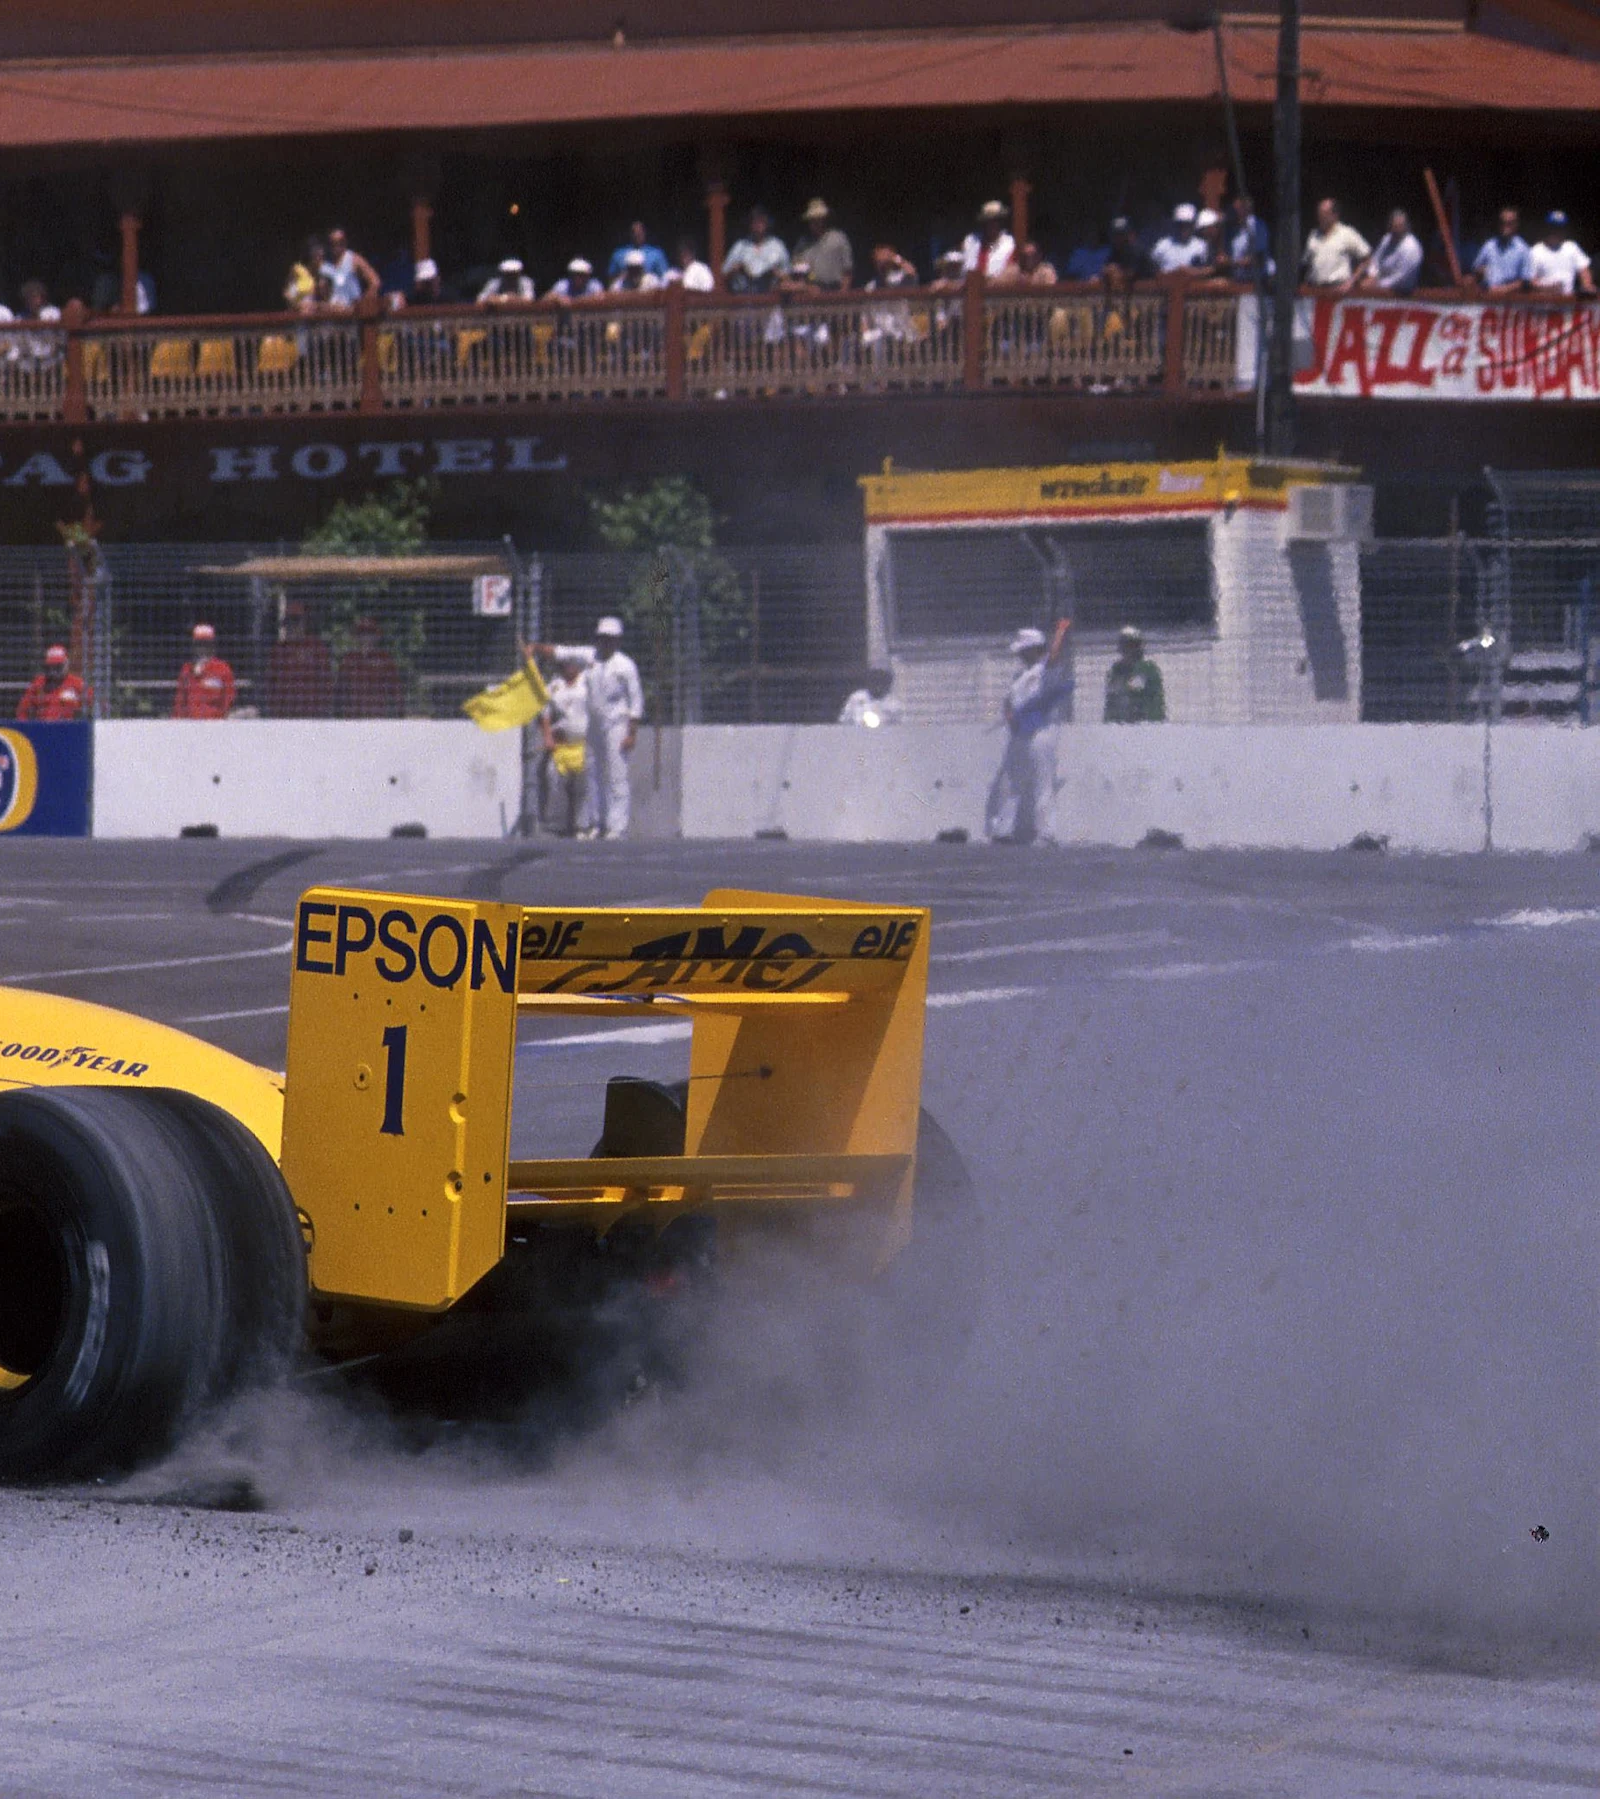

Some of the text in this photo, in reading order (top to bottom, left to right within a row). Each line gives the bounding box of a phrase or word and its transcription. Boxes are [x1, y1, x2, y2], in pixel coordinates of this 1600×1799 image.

[1293, 298, 1439, 398] JAZZ
[209, 435, 568, 483] HOTEL
[297, 901, 519, 995] EPSON
[521, 920, 584, 958] elf
[851, 921, 918, 958] elf
[379, 1024, 408, 1136] 1
